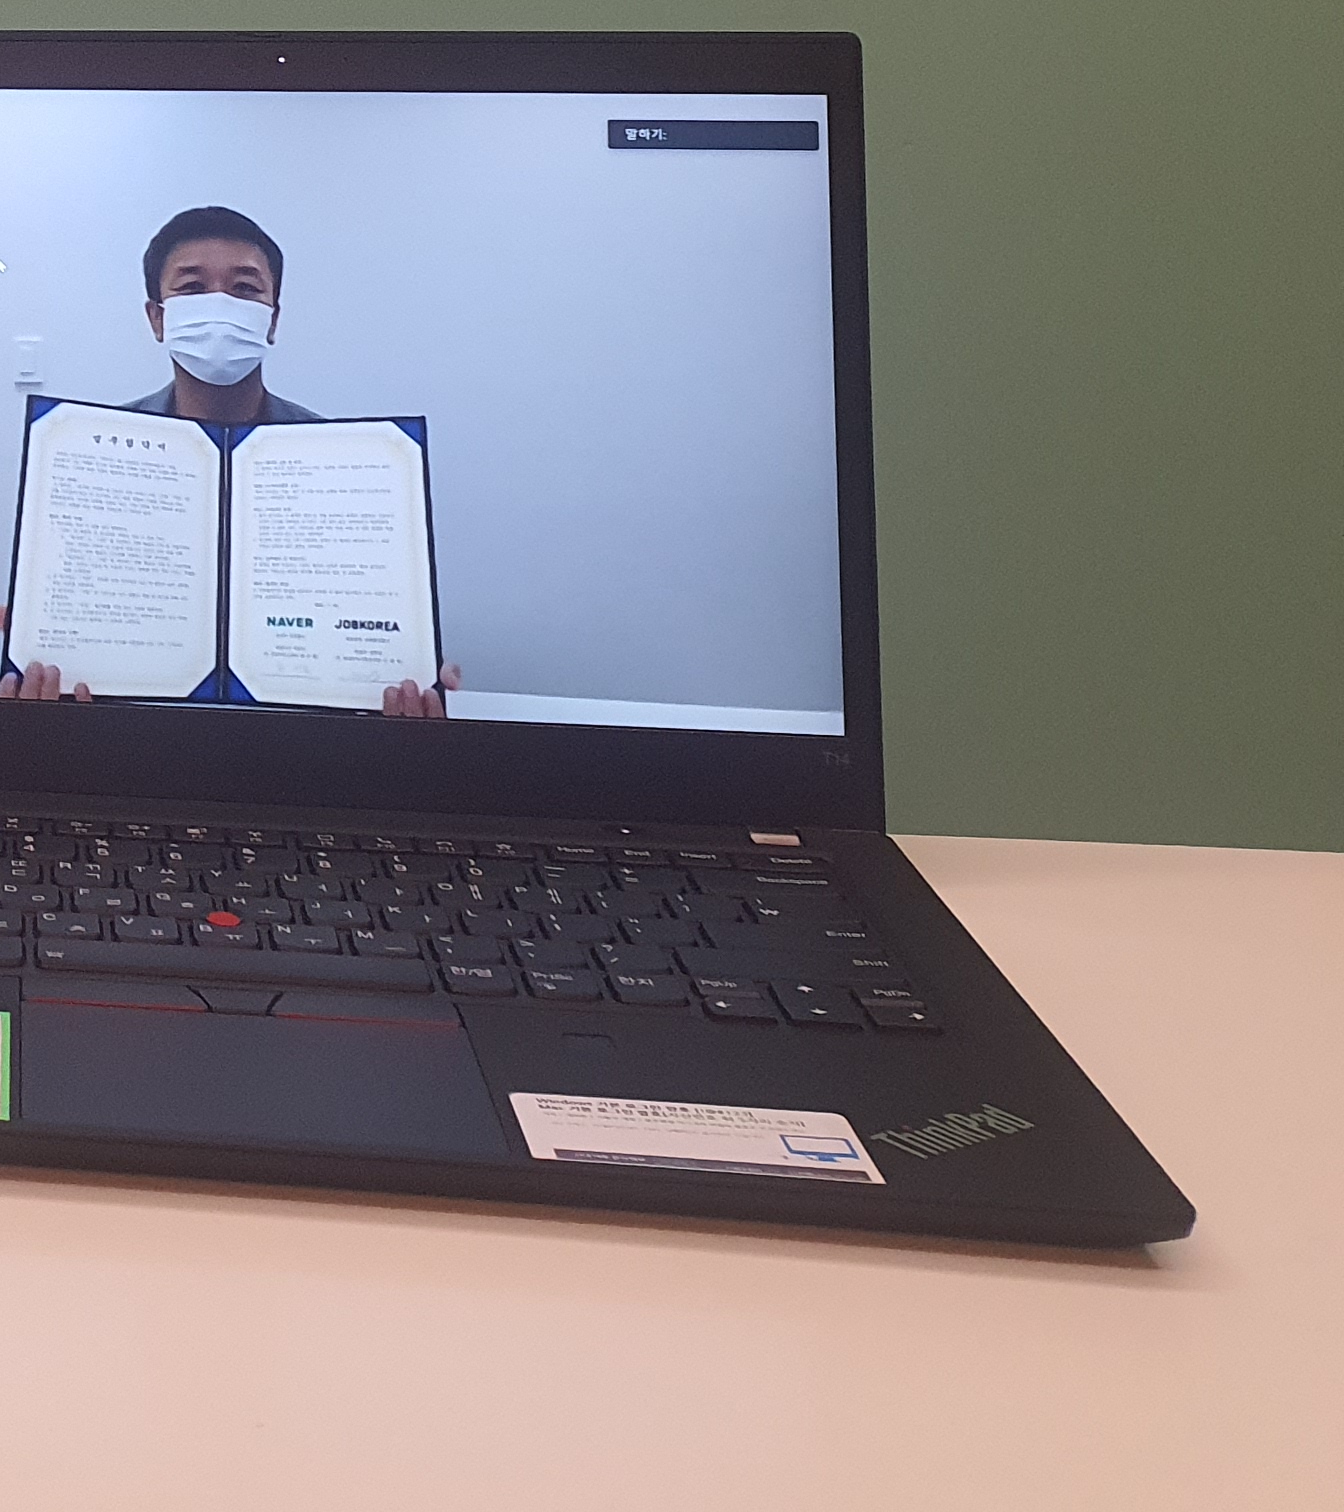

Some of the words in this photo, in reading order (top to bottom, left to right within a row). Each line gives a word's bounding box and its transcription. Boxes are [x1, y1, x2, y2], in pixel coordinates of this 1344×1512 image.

[266, 616, 314, 628] NAVER
[334, 618, 401, 632] JOBKOREA
[357, 930, 374, 939] M
[870, 1104, 1035, 1161] ThinkPad
